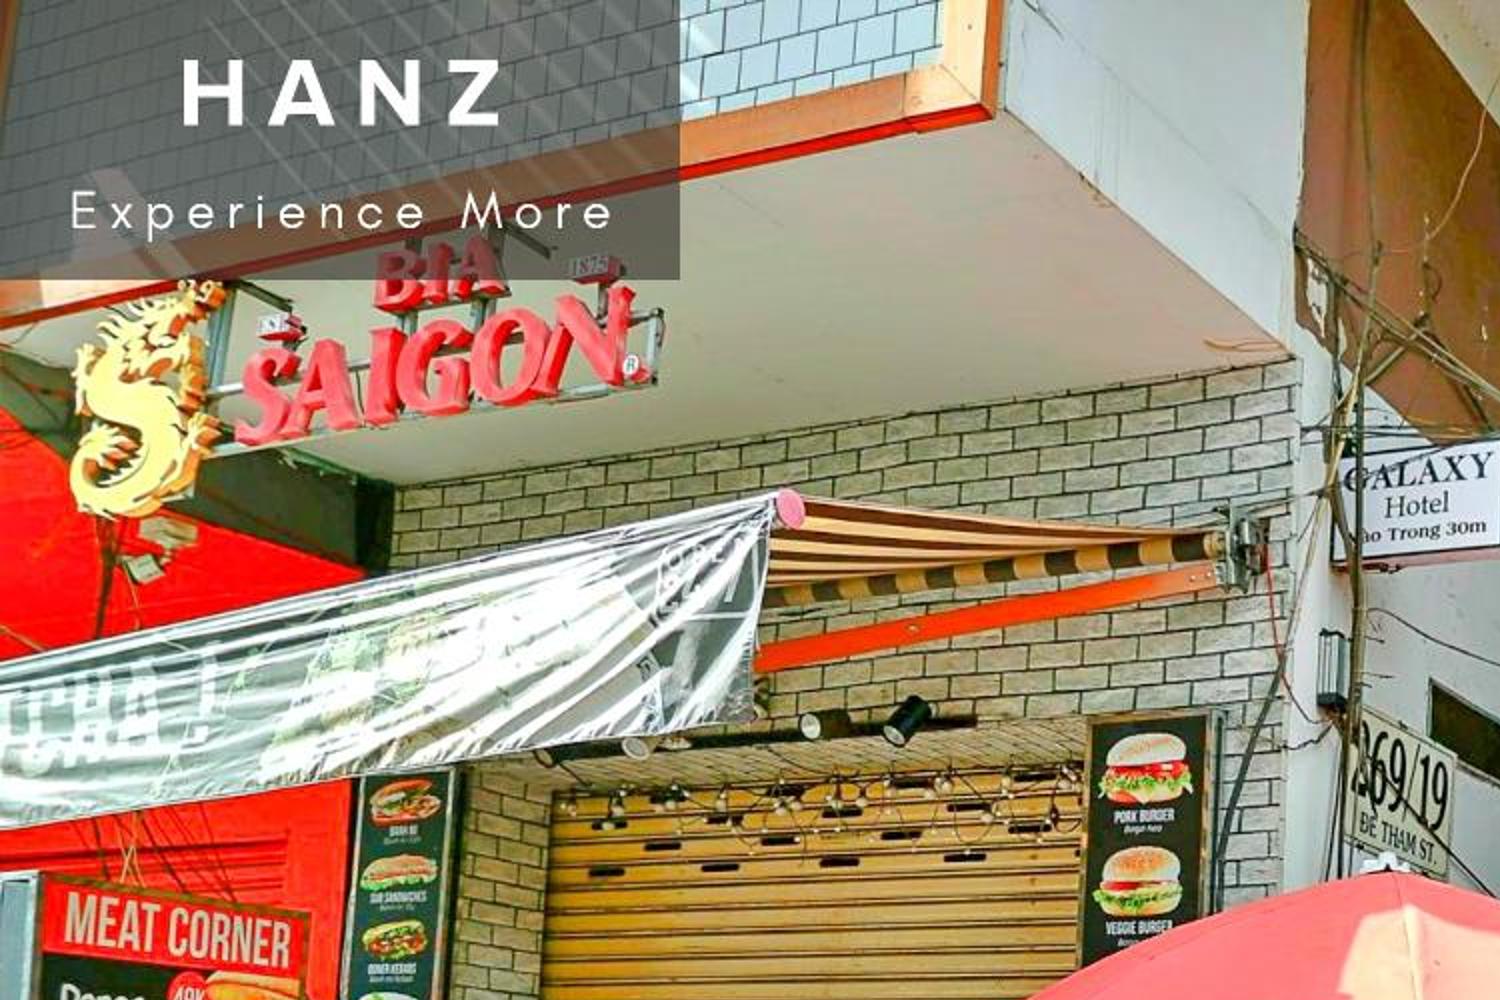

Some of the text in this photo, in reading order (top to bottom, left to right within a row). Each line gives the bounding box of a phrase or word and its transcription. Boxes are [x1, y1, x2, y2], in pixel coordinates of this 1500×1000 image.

[373, 236, 511, 313] BIA
[234, 285, 636, 447] SAIGON
[1344, 451, 1494, 492] GALAXY
[1385, 491, 1449, 518] Hotel
[1388, 524, 1440, 541] Trong
[1446, 520, 1487, 535] 30m
[65, 892, 291, 968] MEAT CORNER
